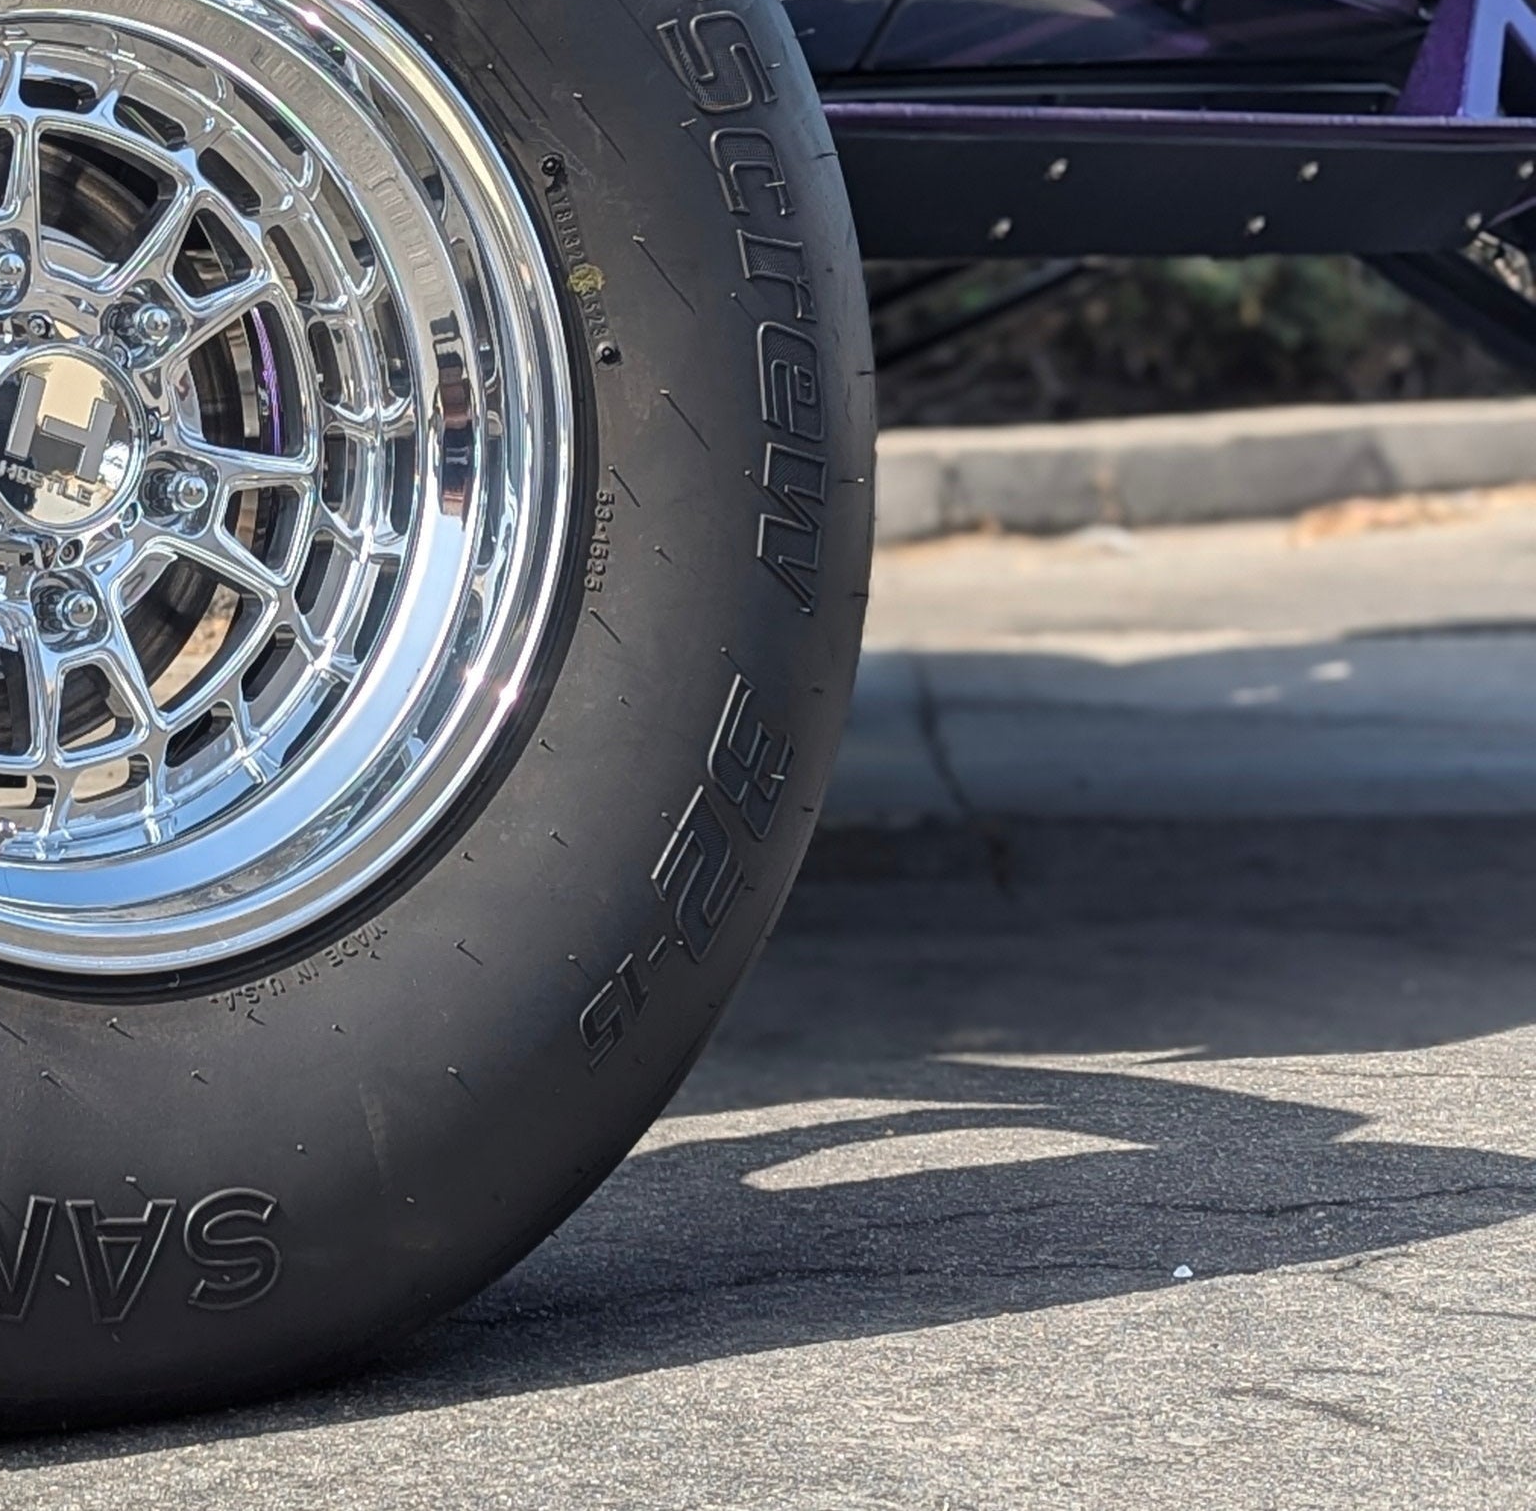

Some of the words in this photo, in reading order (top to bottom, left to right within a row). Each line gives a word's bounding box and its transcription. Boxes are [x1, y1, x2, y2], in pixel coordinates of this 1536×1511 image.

[655, 9, 828, 617] Screw
[323, 921, 390, 969] MADE
[296, 958, 321, 986] IN
